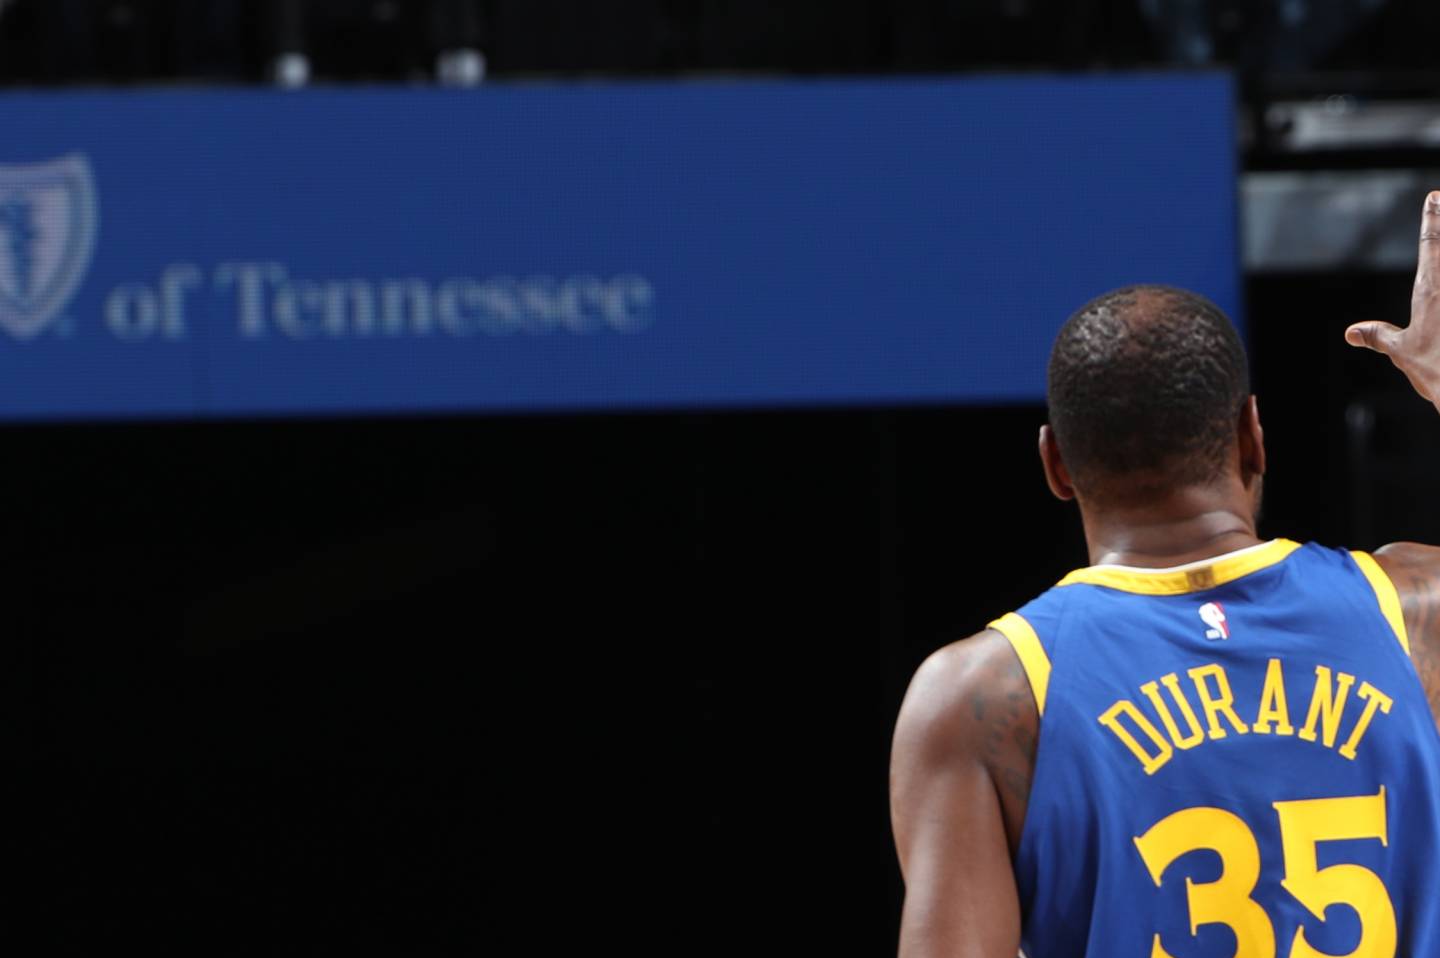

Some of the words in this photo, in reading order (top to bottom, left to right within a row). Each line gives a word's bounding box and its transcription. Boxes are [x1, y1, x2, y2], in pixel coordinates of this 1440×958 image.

[105, 262, 202, 340] of
[212, 260, 656, 340] Tennessee
[1097, 658, 1394, 776] DURANT
